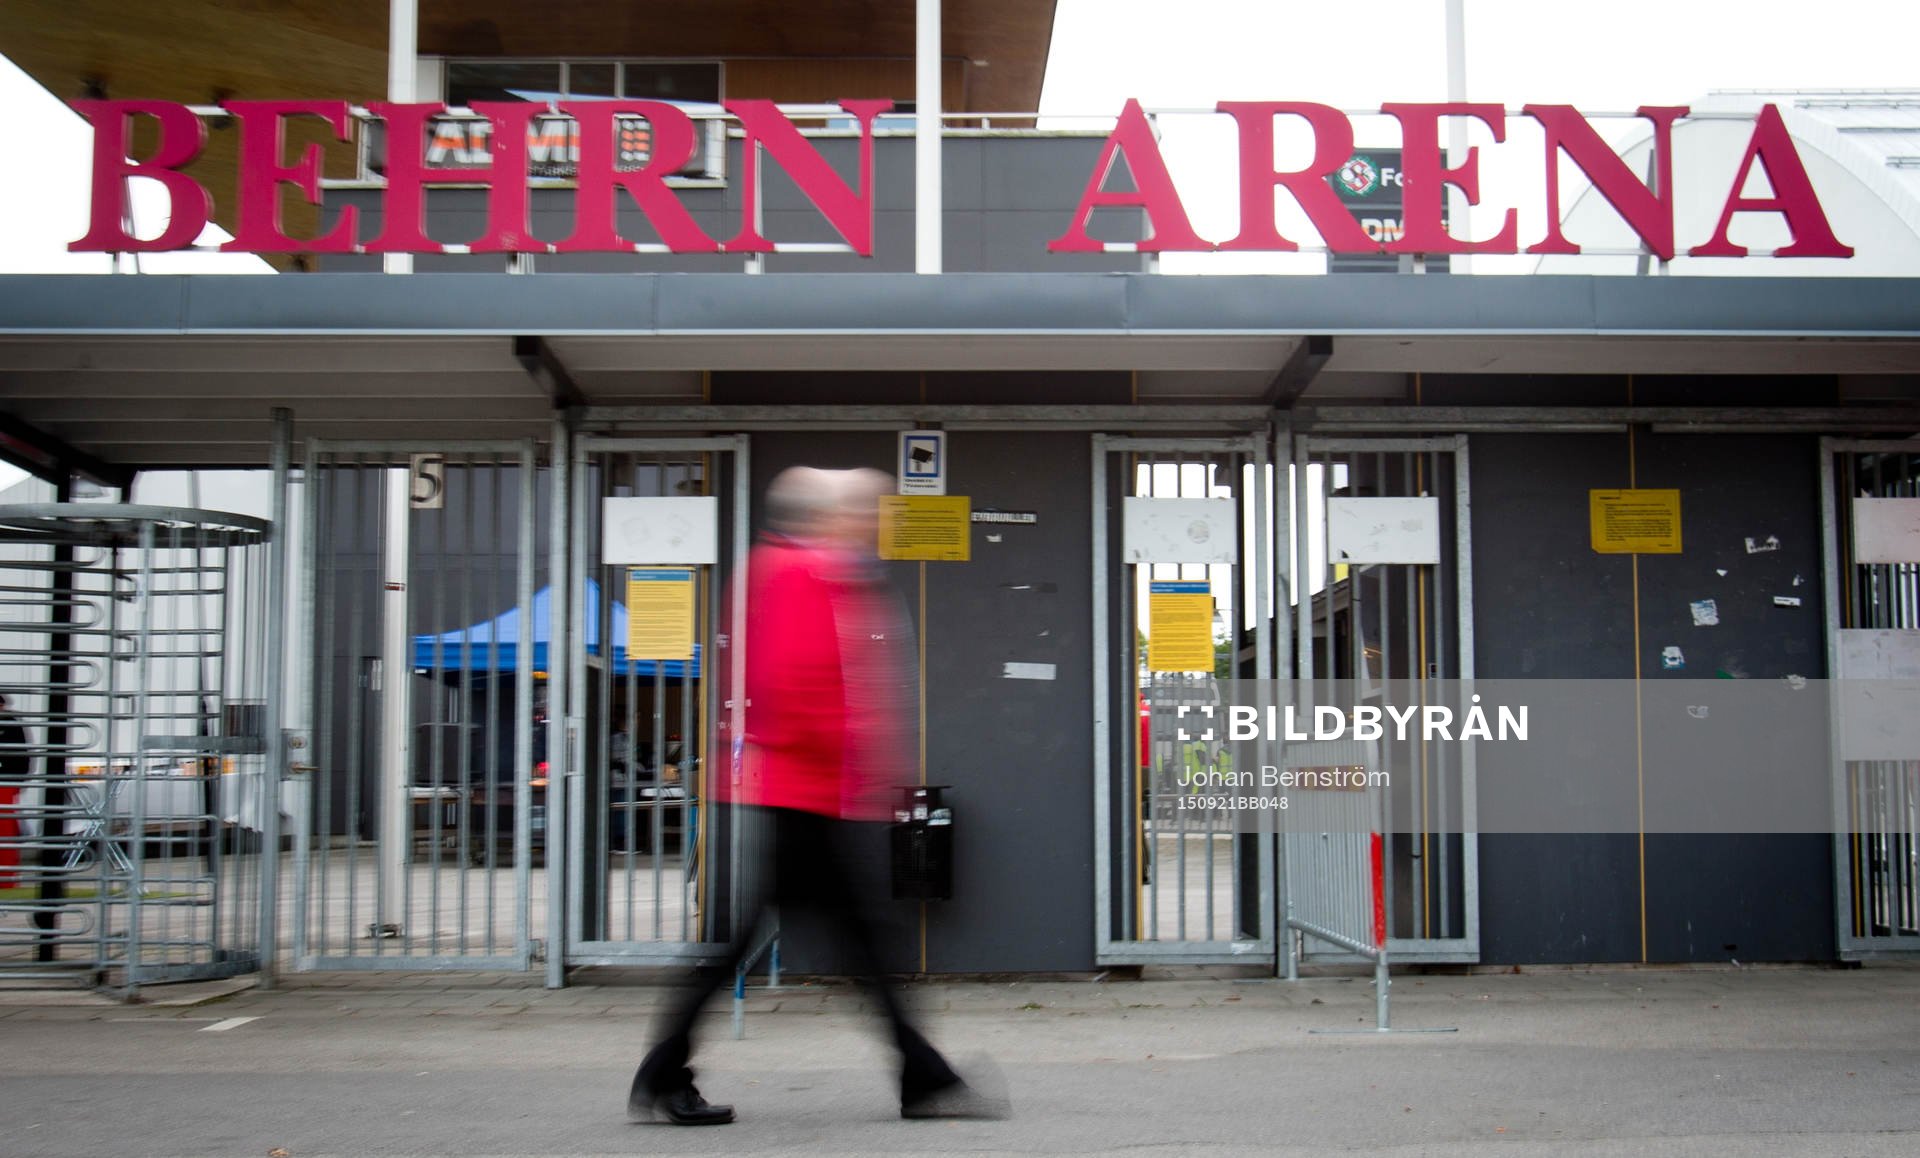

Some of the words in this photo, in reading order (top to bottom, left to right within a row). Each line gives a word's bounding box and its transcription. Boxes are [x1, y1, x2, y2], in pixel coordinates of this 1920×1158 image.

[68, 99, 894, 257] BEHRN
[1049, 98, 1855, 260] ARENA
[411, 457, 442, 504] 5
